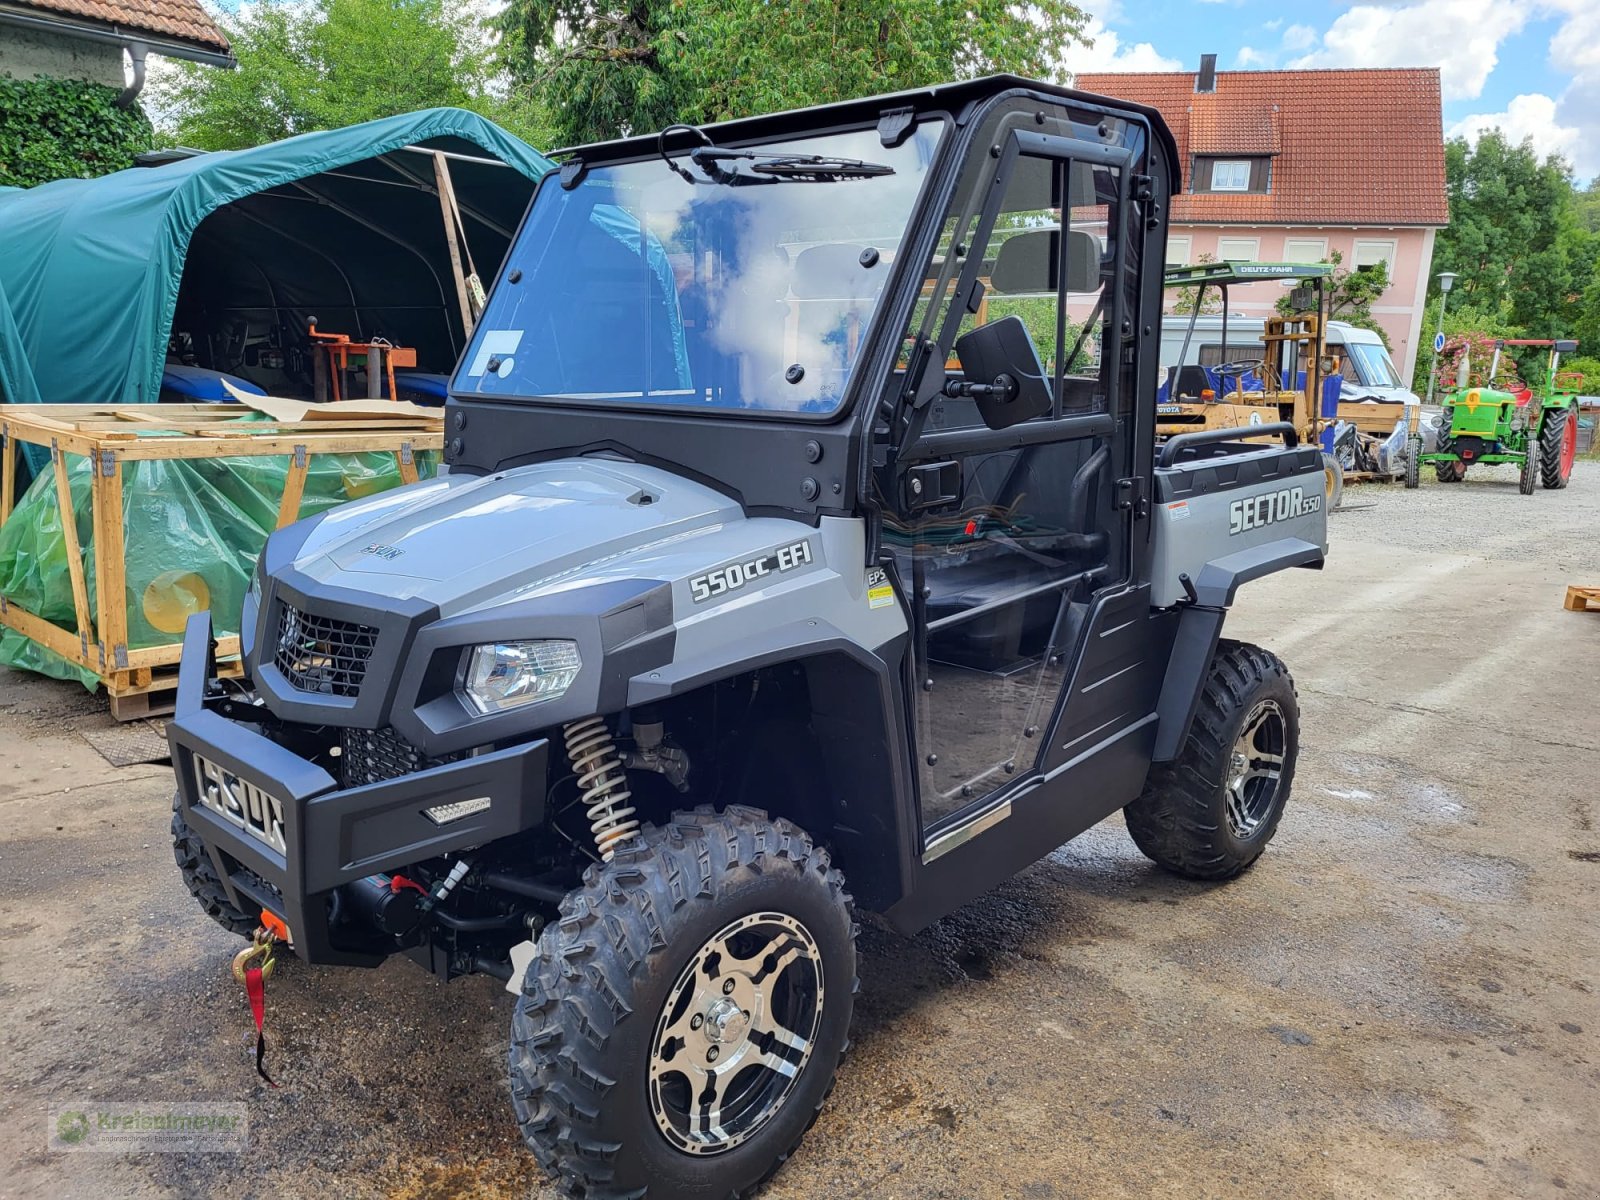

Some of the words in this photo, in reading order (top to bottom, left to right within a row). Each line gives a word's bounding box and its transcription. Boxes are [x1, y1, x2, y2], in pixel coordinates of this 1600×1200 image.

[1229, 486, 1304, 535] SECTOR
[1302, 495, 1321, 515] 550
[777, 541, 811, 571] EFI
[868, 568, 886, 585] EPS
